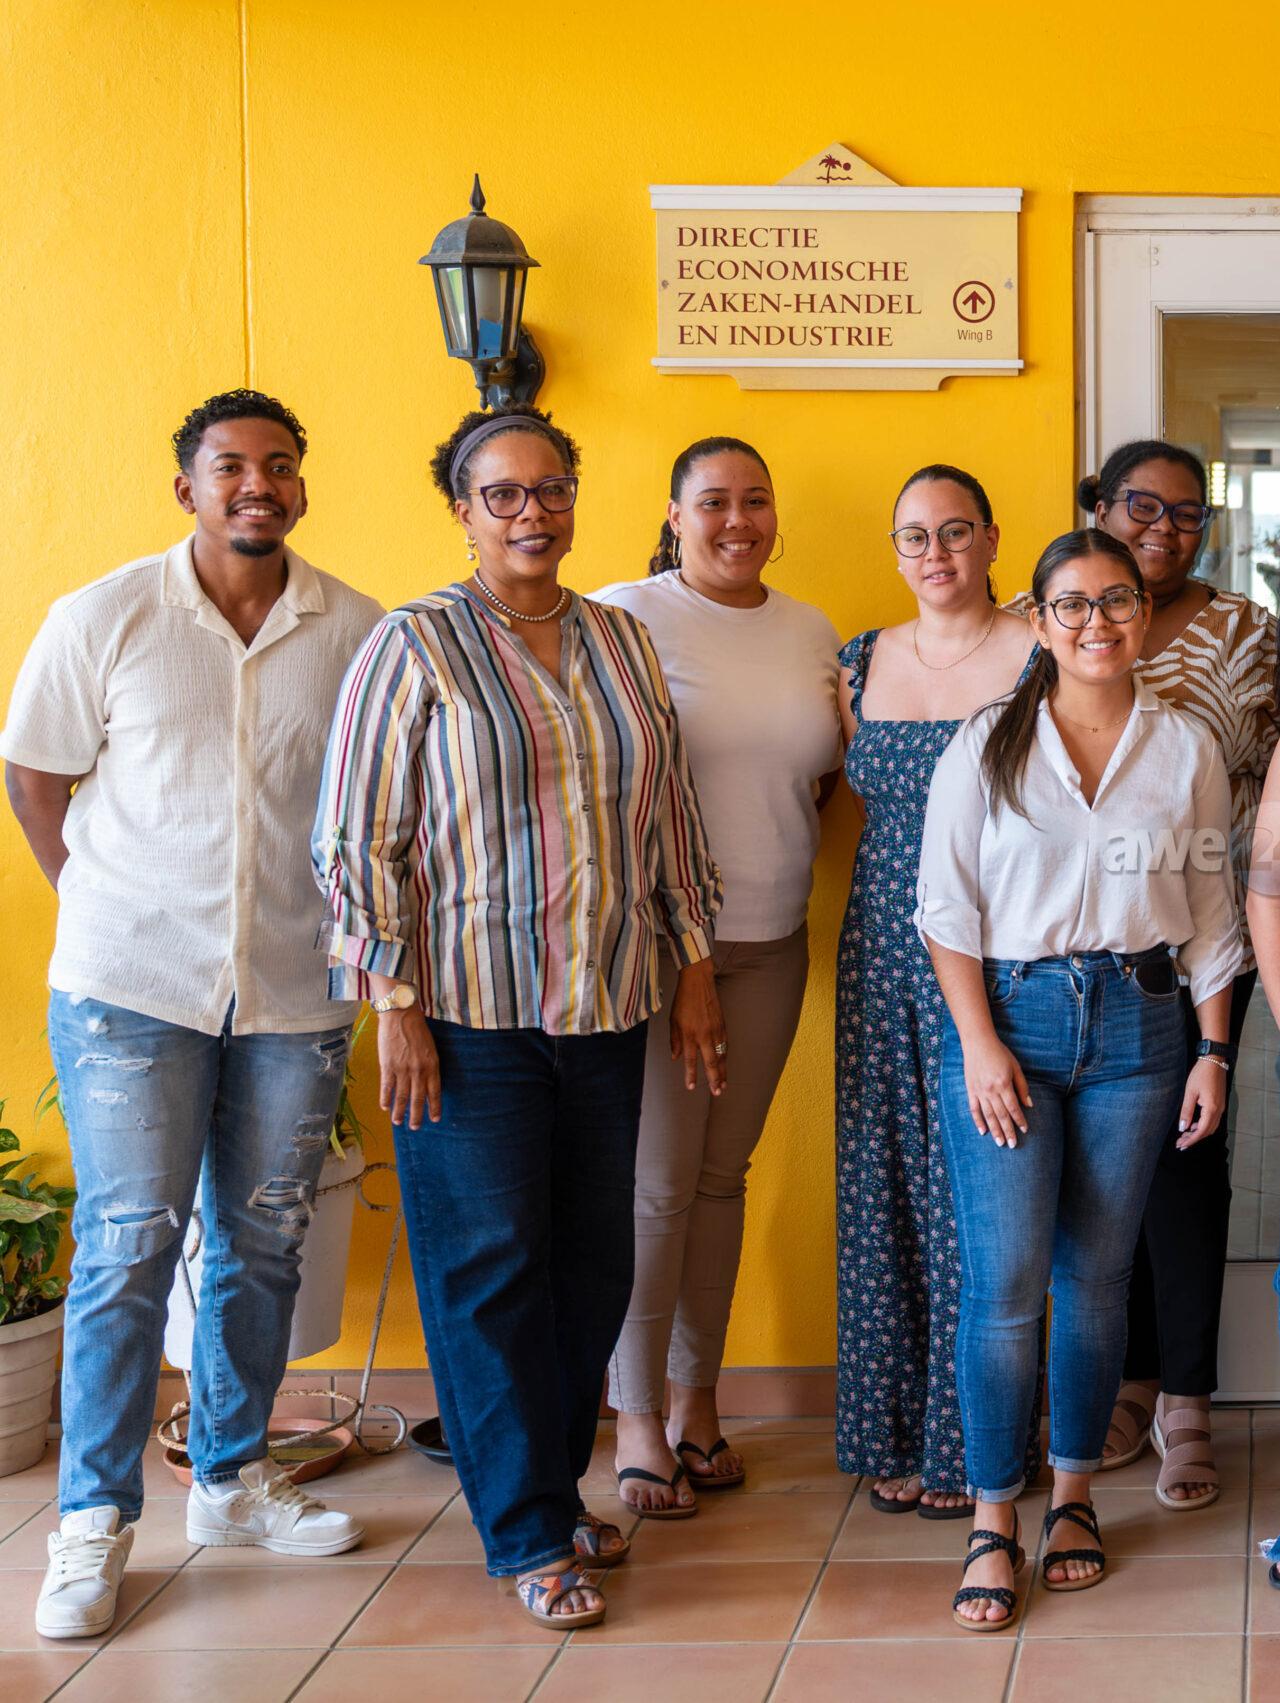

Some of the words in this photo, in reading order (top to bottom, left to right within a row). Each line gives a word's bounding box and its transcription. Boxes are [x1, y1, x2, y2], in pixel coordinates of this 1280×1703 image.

[676, 227, 819, 248] DIRECTIE
[676, 259, 910, 282] ECONOMISCHE
[677, 291, 923, 315] ZAKEN-HANDEL
[678, 324, 718, 345] EN
[728, 325, 894, 347] INDUSTRIE
[957, 329, 983, 343] Wing
[986, 330, 993, 341] B
